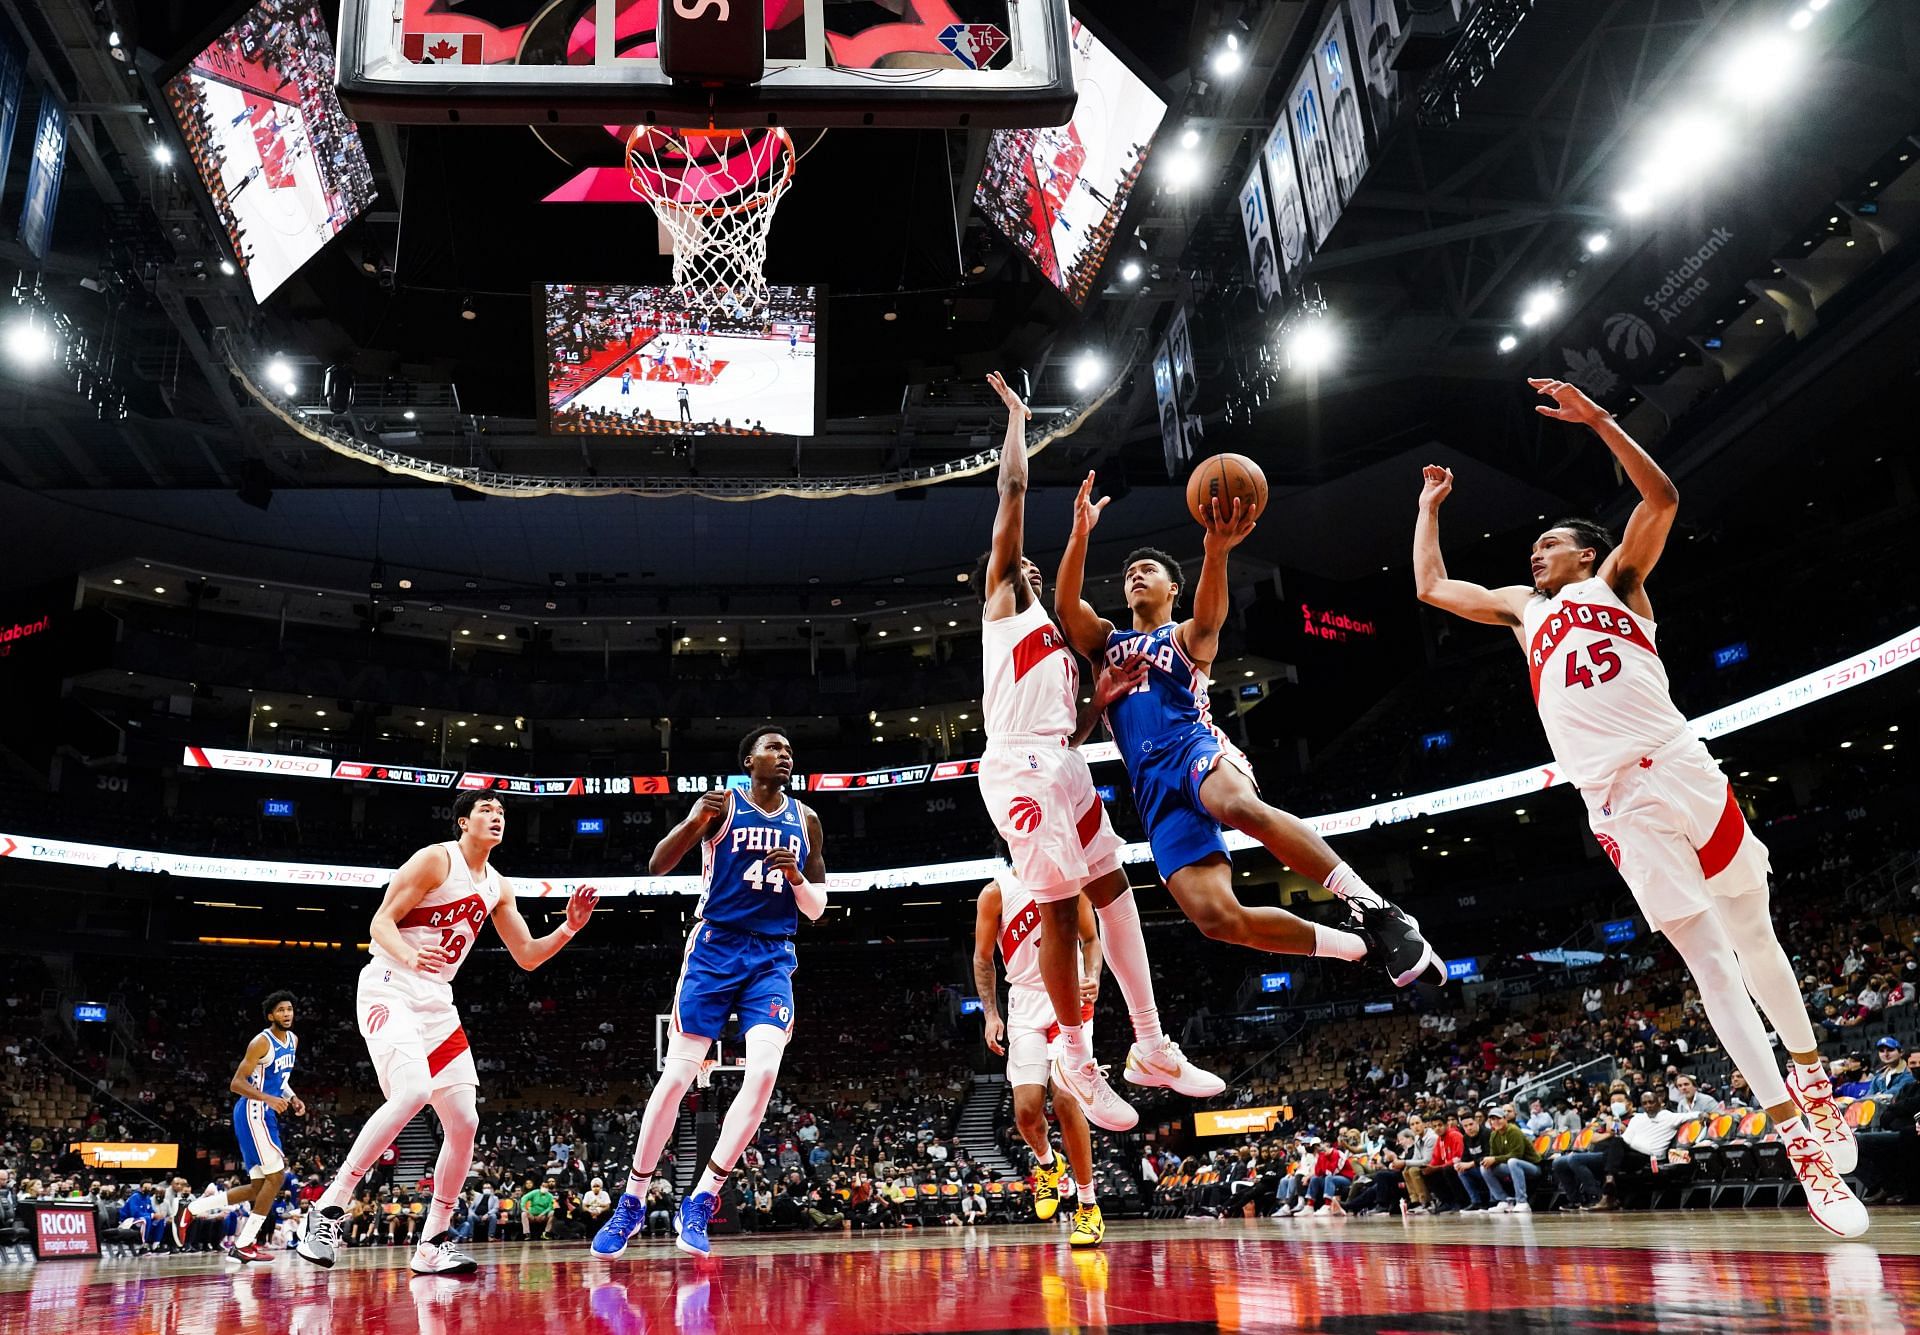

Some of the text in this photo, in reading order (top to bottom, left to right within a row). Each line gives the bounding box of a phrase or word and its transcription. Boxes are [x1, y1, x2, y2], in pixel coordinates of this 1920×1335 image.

[979, 31, 993, 46] 75
[1643, 227, 1734, 311] Scotiabank
[1658, 277, 1711, 323] Arena
[566, 351, 580, 360] LG
[1533, 605, 1633, 667] RAPTORS
[1565, 638, 1622, 689] 45
[1822, 662, 1868, 689] TSN
[1878, 637, 1920, 669] 1050
[274, 759, 320, 772] 1050
[96, 775, 129, 793] 301
[677, 777, 707, 792] 8:16
[269, 803, 289, 813] IBM
[926, 797, 957, 813] 304
[580, 822, 600, 831] IBM
[622, 810, 653, 825] 303
[731, 827, 802, 863] PHILA
[31, 845, 97, 861] OVERDRIVE
[334, 871, 375, 883] 1050
[743, 859, 785, 893] 44
[430, 902, 485, 932] RAPTO
[440, 929, 467, 964] 18
[1450, 962, 1472, 976] IBM
[1266, 976, 1286, 988] IBM
[79, 1006, 102, 1018] IBM
[769, 1003, 790, 1023] 76
[274, 1054, 296, 1074] PHIL
[280, 1072, 291, 1090] 7
[41, 1213, 87, 1235] RICOH
